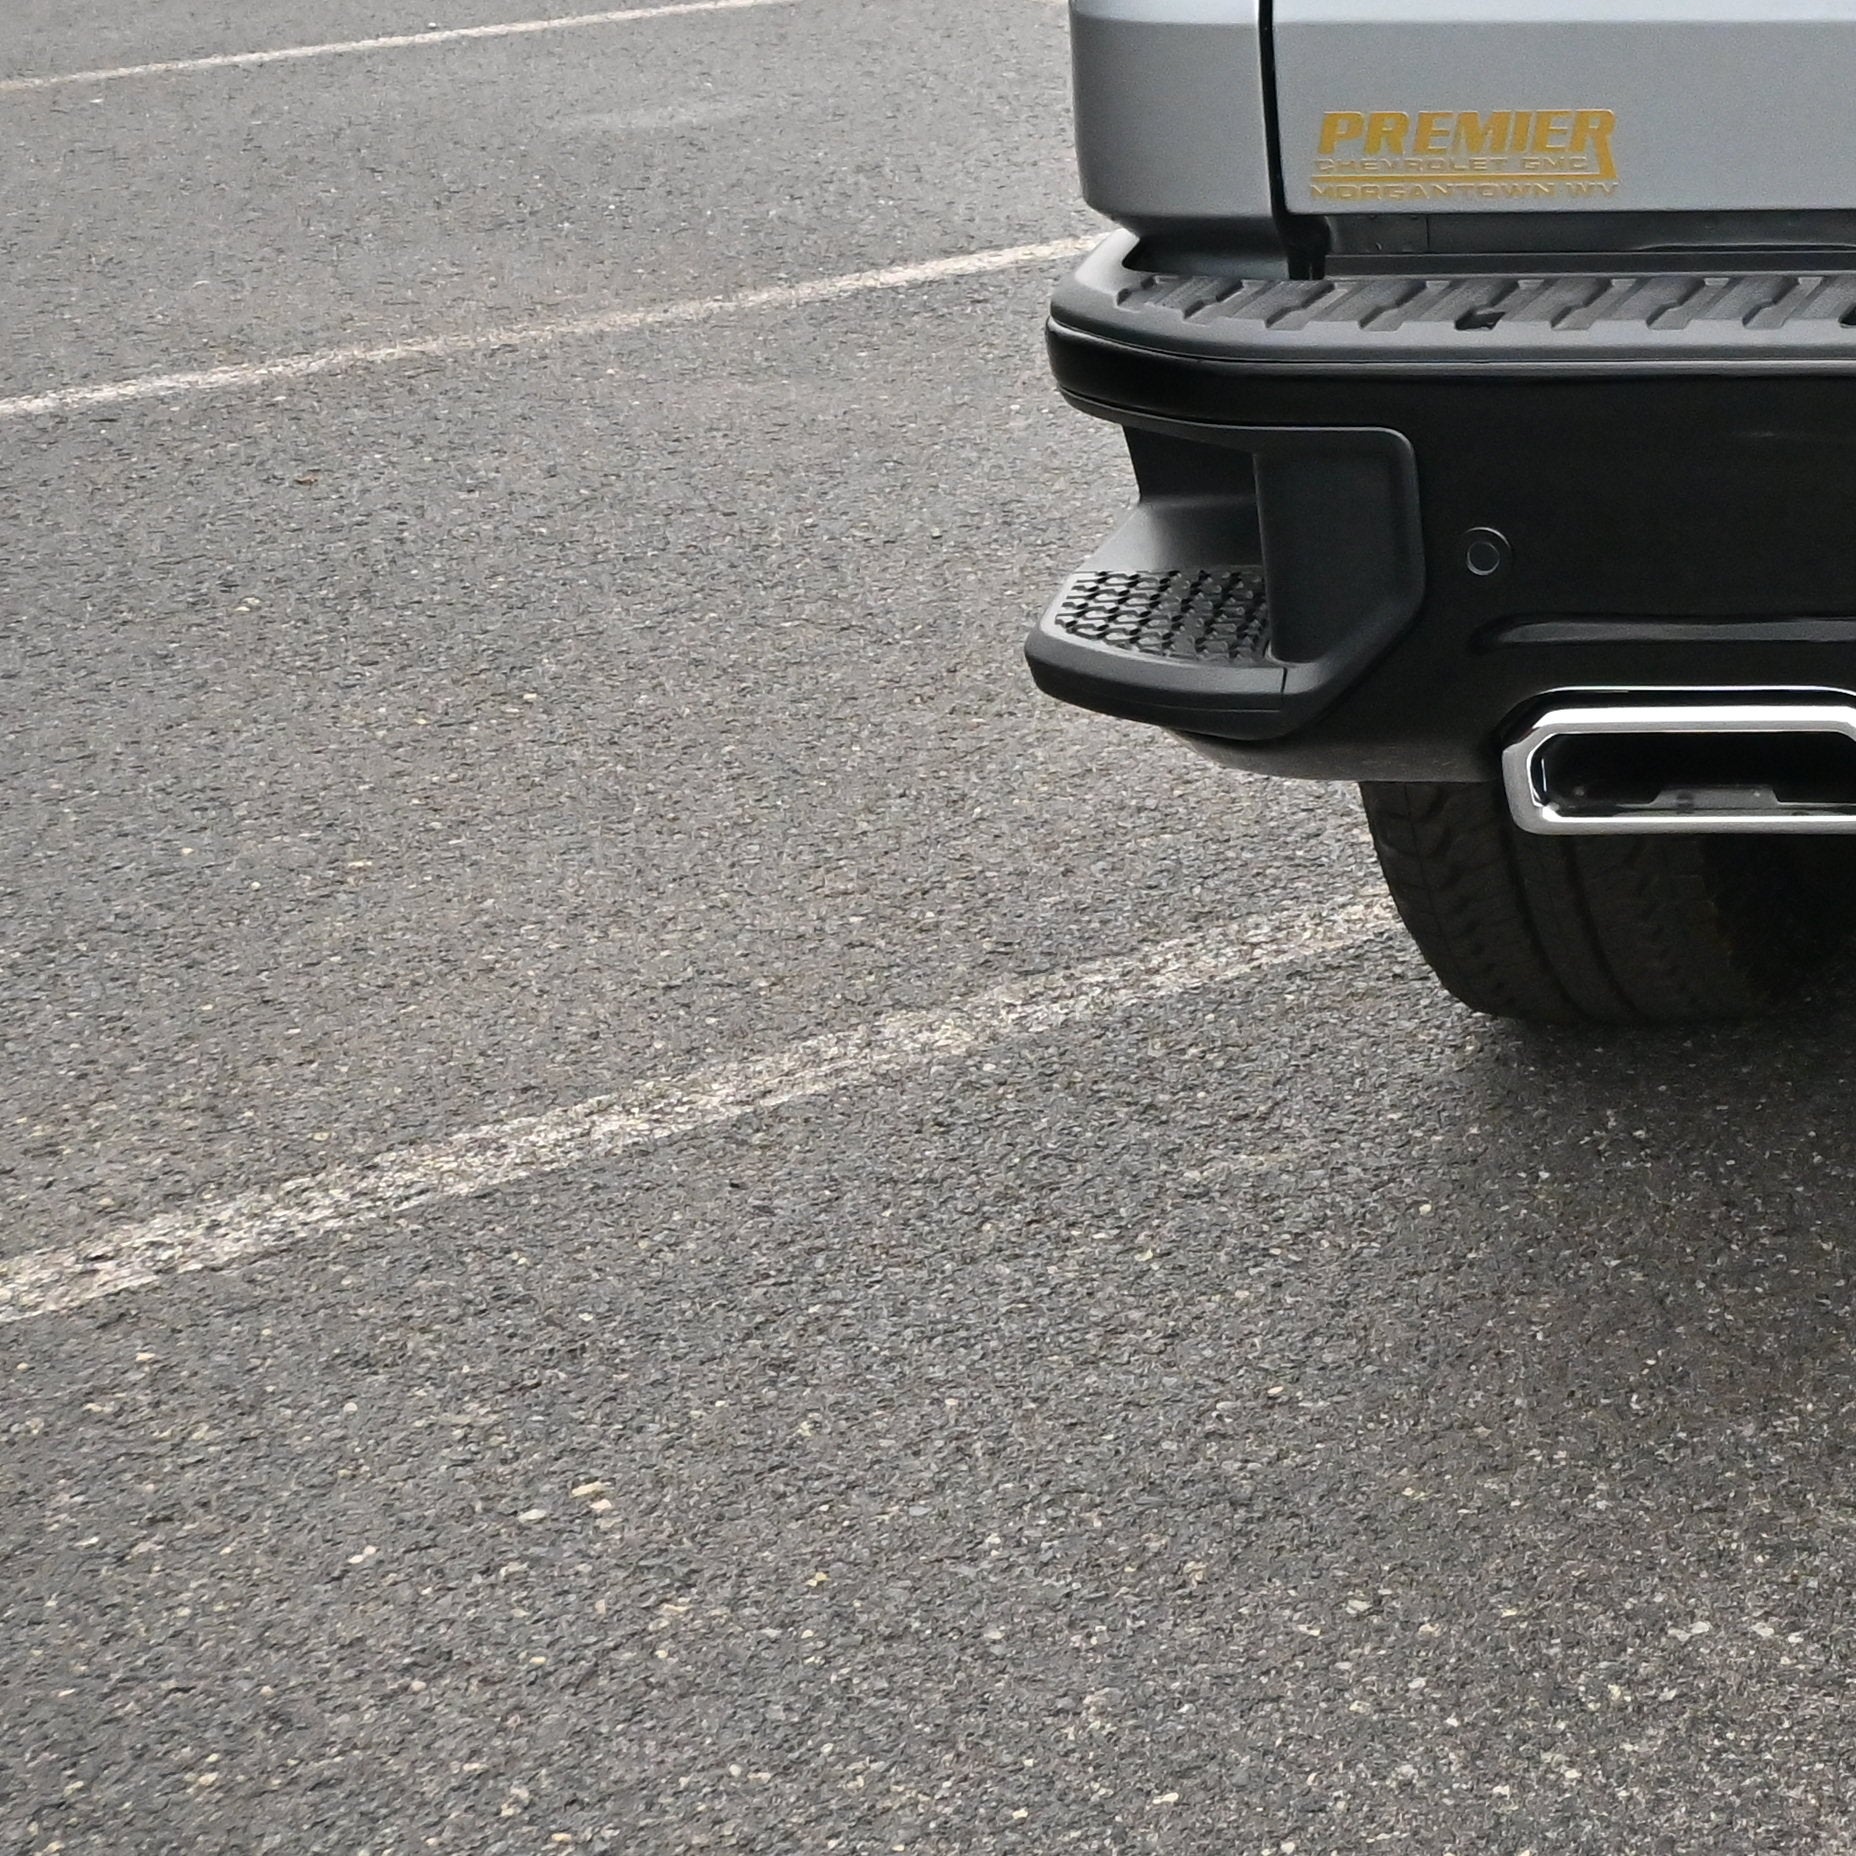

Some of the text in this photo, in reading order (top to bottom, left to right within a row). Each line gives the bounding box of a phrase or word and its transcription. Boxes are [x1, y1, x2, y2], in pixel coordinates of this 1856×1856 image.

[1316, 108, 1618, 178] PREMIER
[1312, 156, 1590, 172] CHEVROLET GMC
[1310, 181, 1620, 201] MORGANTOWN WV
